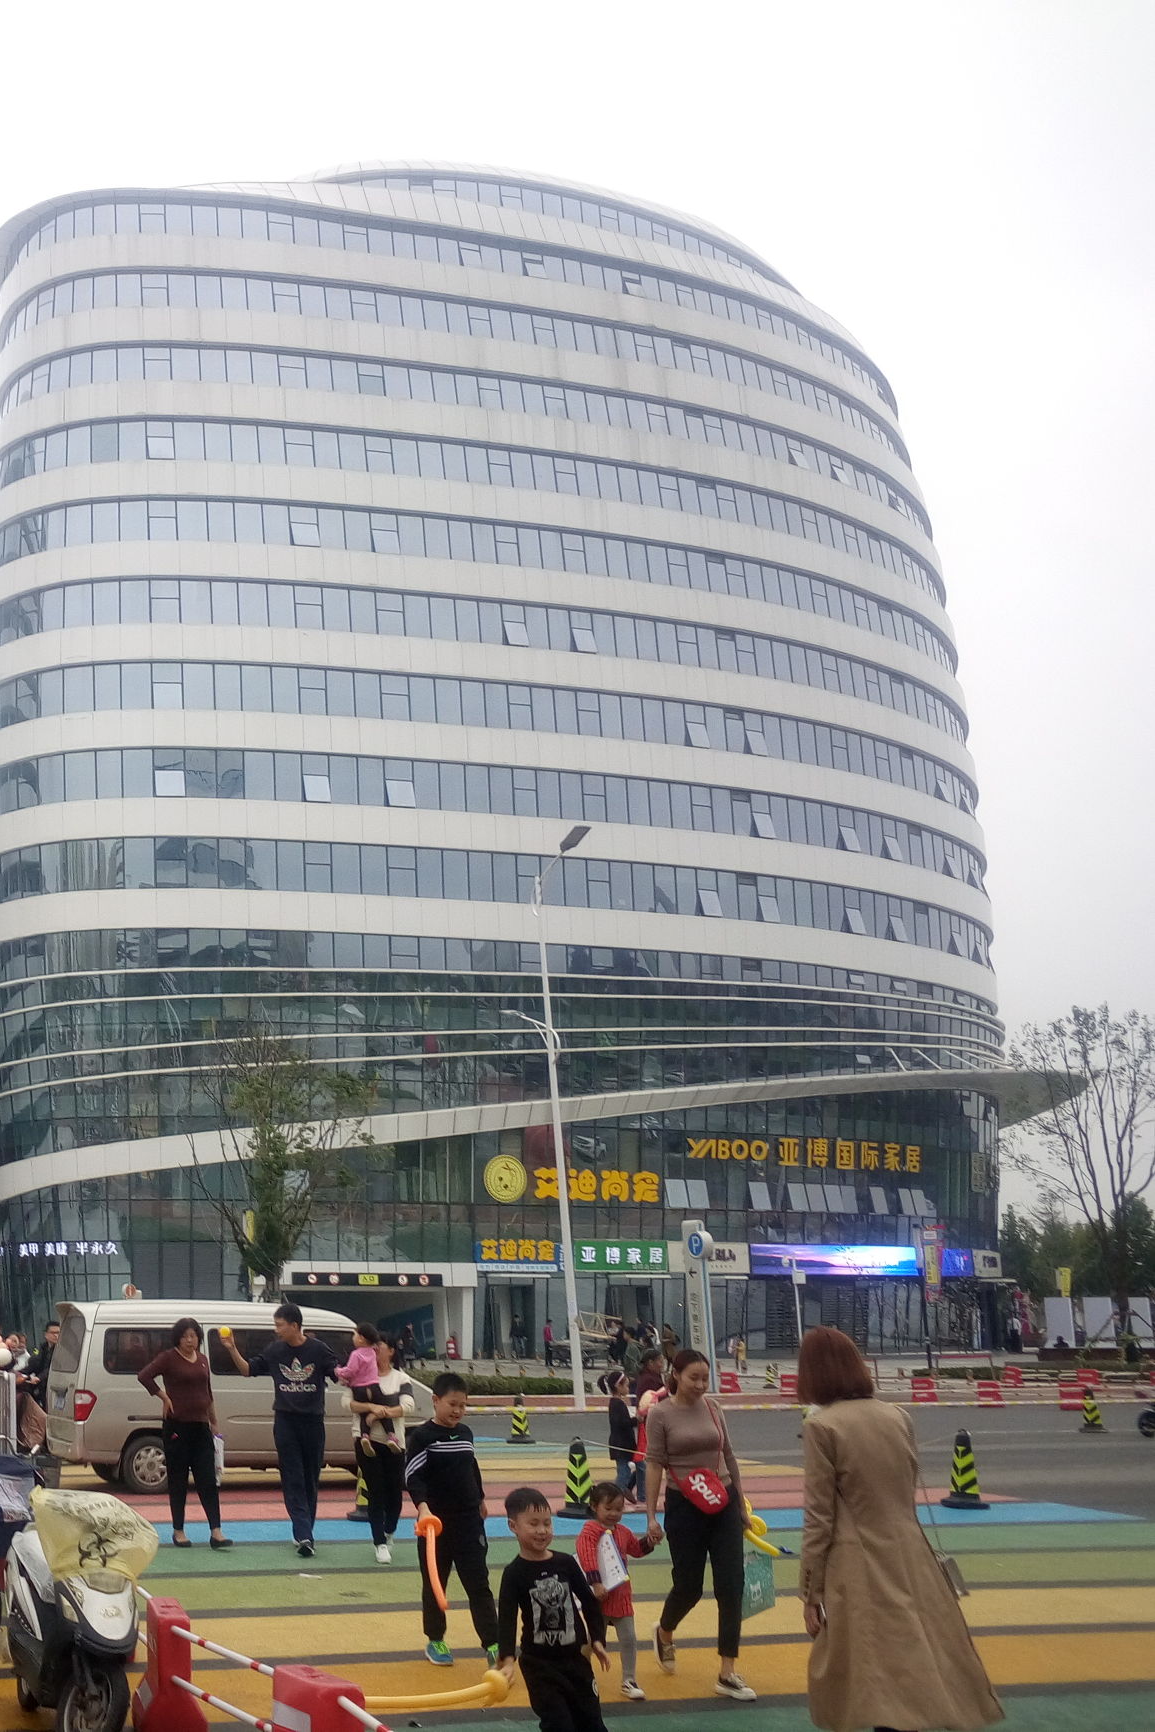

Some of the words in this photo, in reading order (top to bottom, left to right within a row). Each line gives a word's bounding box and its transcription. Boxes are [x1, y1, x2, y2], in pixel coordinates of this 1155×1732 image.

[686, 1138, 769, 1160] YABOO
[778, 1137, 922, 1173] 亚博国际家居
[19, 1243, 39, 1257] 美甲
[76, 1241, 118, 1255] 半永久
[581, 1246, 663, 1264] 亚博家居
[279, 1381, 317, 1392] adidas
